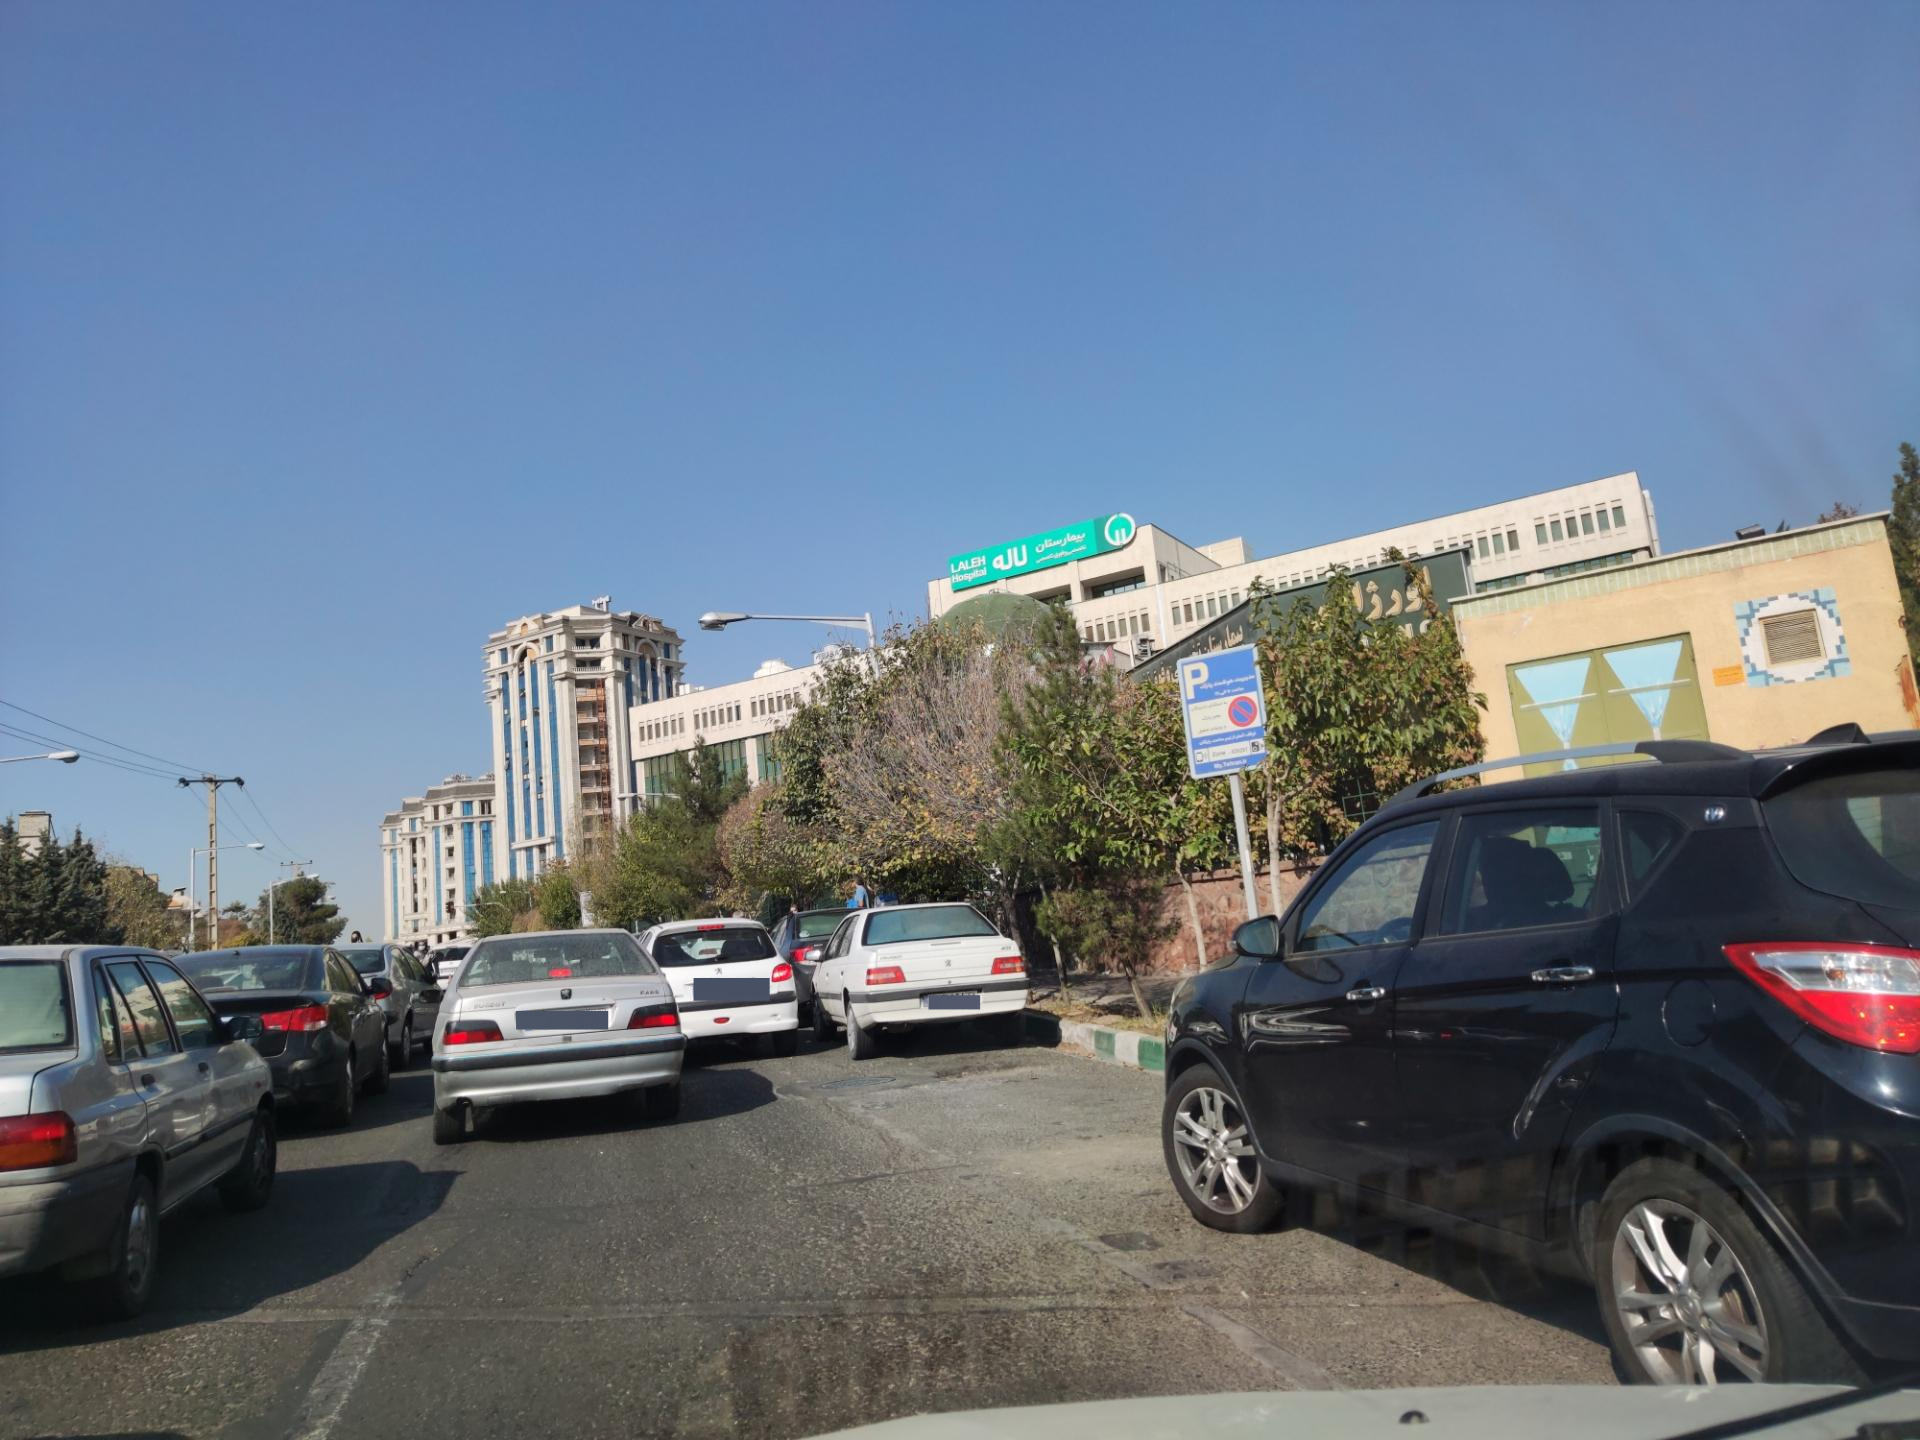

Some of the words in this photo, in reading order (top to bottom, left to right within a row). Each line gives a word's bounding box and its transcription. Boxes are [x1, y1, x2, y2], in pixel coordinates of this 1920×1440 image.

[1035, 532, 1086, 553] بیمارستان
[951, 555, 986, 574] LALEH
[992, 544, 1028, 571] لاله
[952, 567, 987, 583] Hospital
[1183, 662, 1209, 700] P
